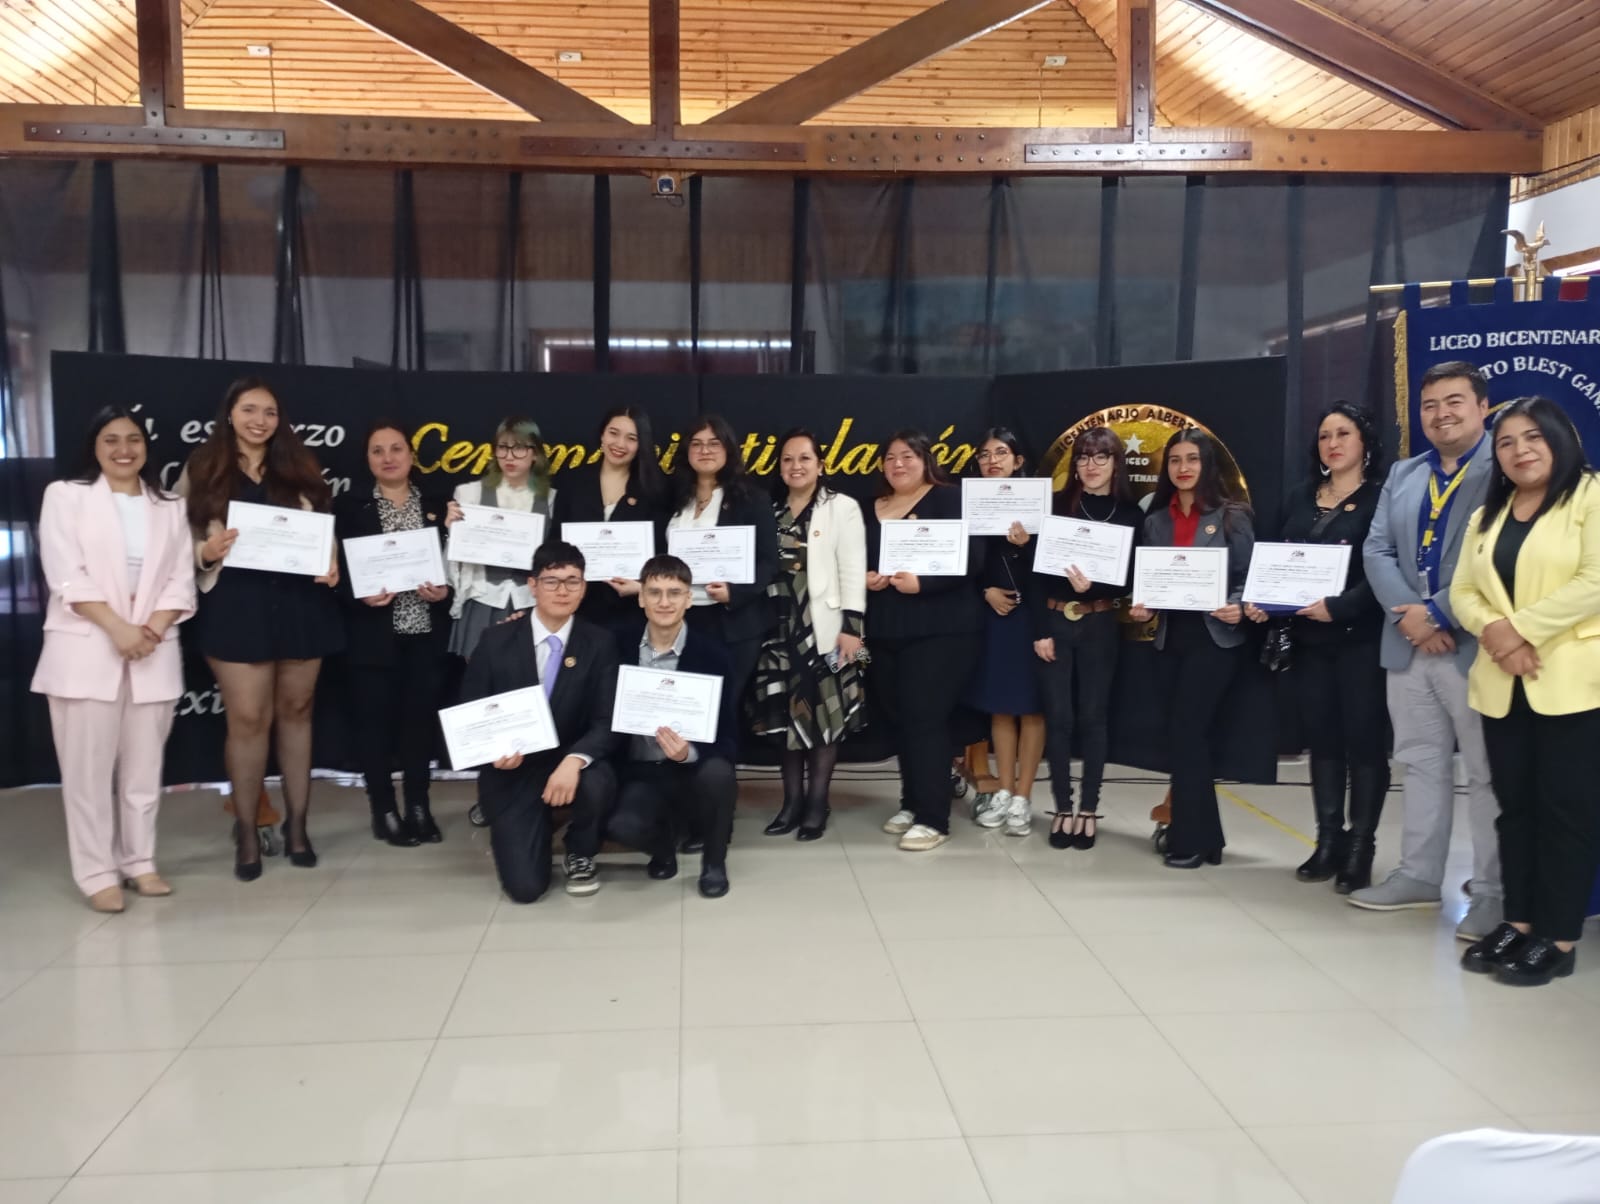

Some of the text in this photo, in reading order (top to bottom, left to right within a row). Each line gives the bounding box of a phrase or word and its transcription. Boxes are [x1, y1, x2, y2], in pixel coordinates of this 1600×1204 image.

[1430, 329, 1600, 351] LICEO BICENTENAR
[1513, 356, 1572, 379] BLEST
[1147, 408, 1197, 430] ALBERT
